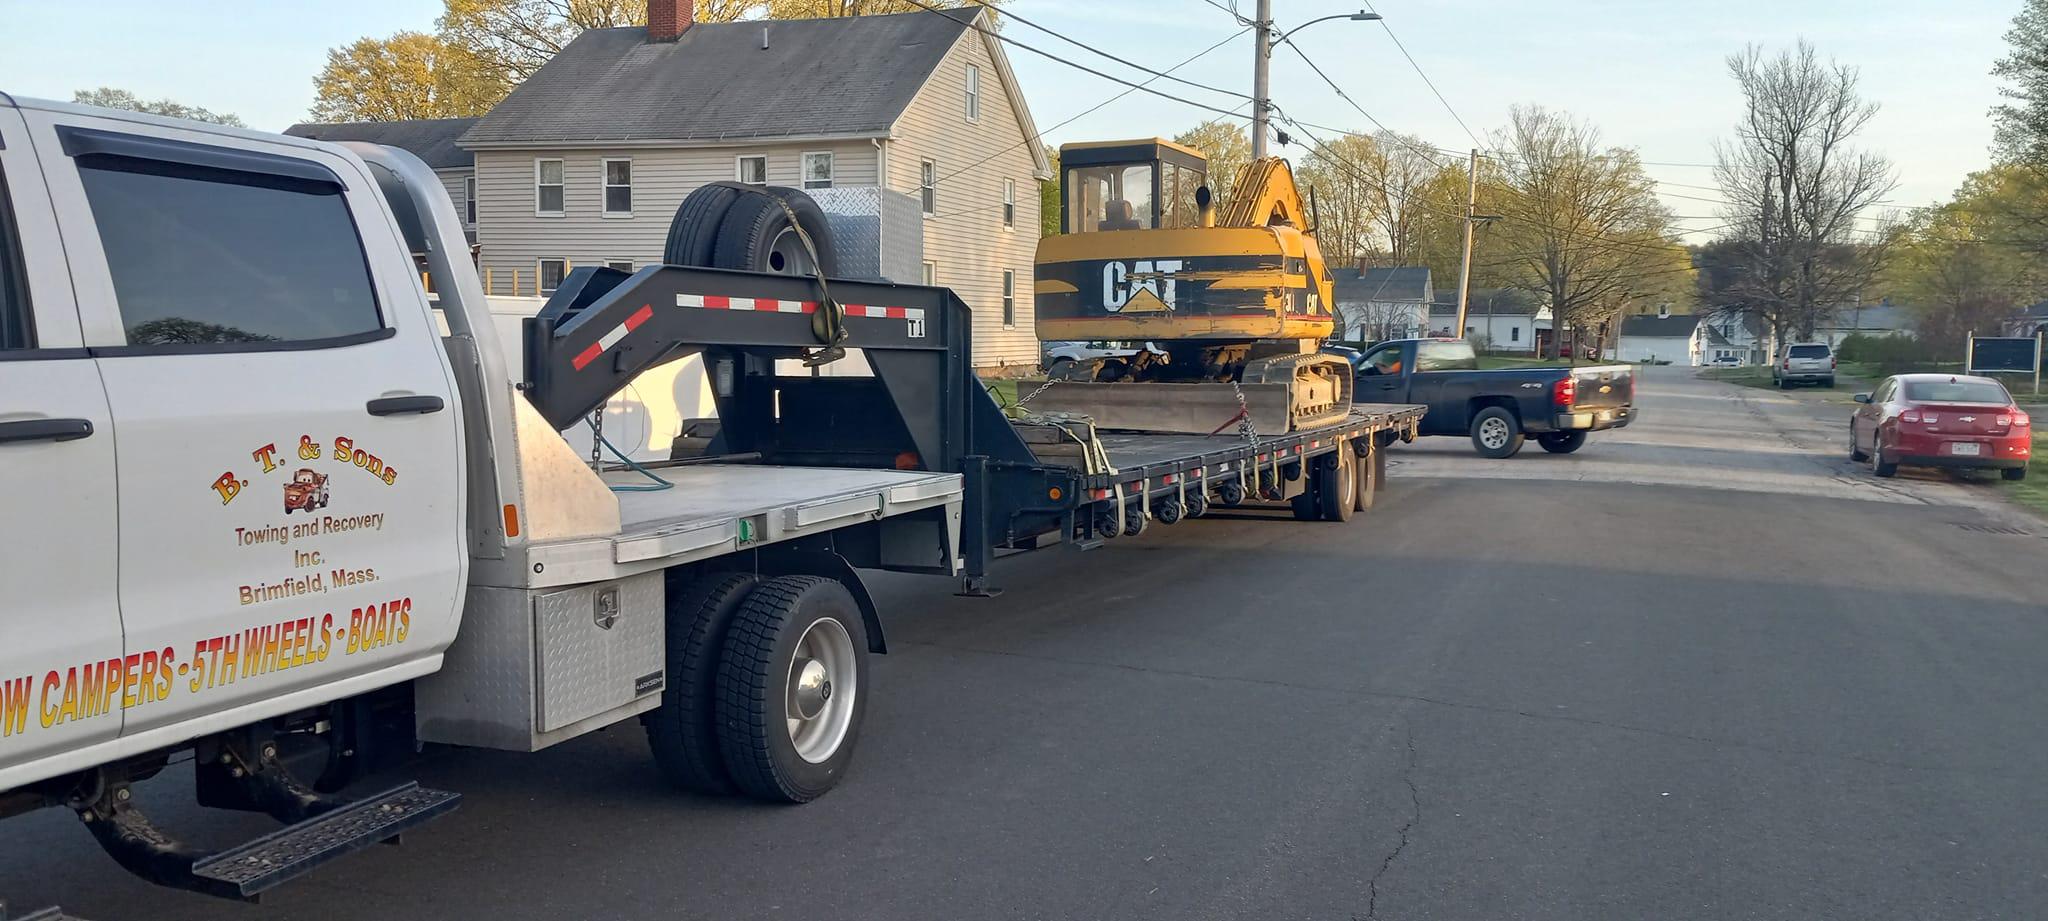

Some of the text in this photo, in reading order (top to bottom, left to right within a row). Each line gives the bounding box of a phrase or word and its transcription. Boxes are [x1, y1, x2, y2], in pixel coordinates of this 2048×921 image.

[1103, 260, 1182, 312] CAT
[908, 319, 923, 337] T1
[211, 434, 398, 506] B. T. & Sons
[235, 513, 384, 546] Towing and Recovery
[294, 549, 325, 568] Inc.
[238, 567, 379, 606] Brimfield, Mass.
[39, 646, 175, 729] CAMPERS
[190, 633, 241, 694] 5TH
[241, 612, 333, 679] WHEELS
[345, 597, 412, 656] BOATS
